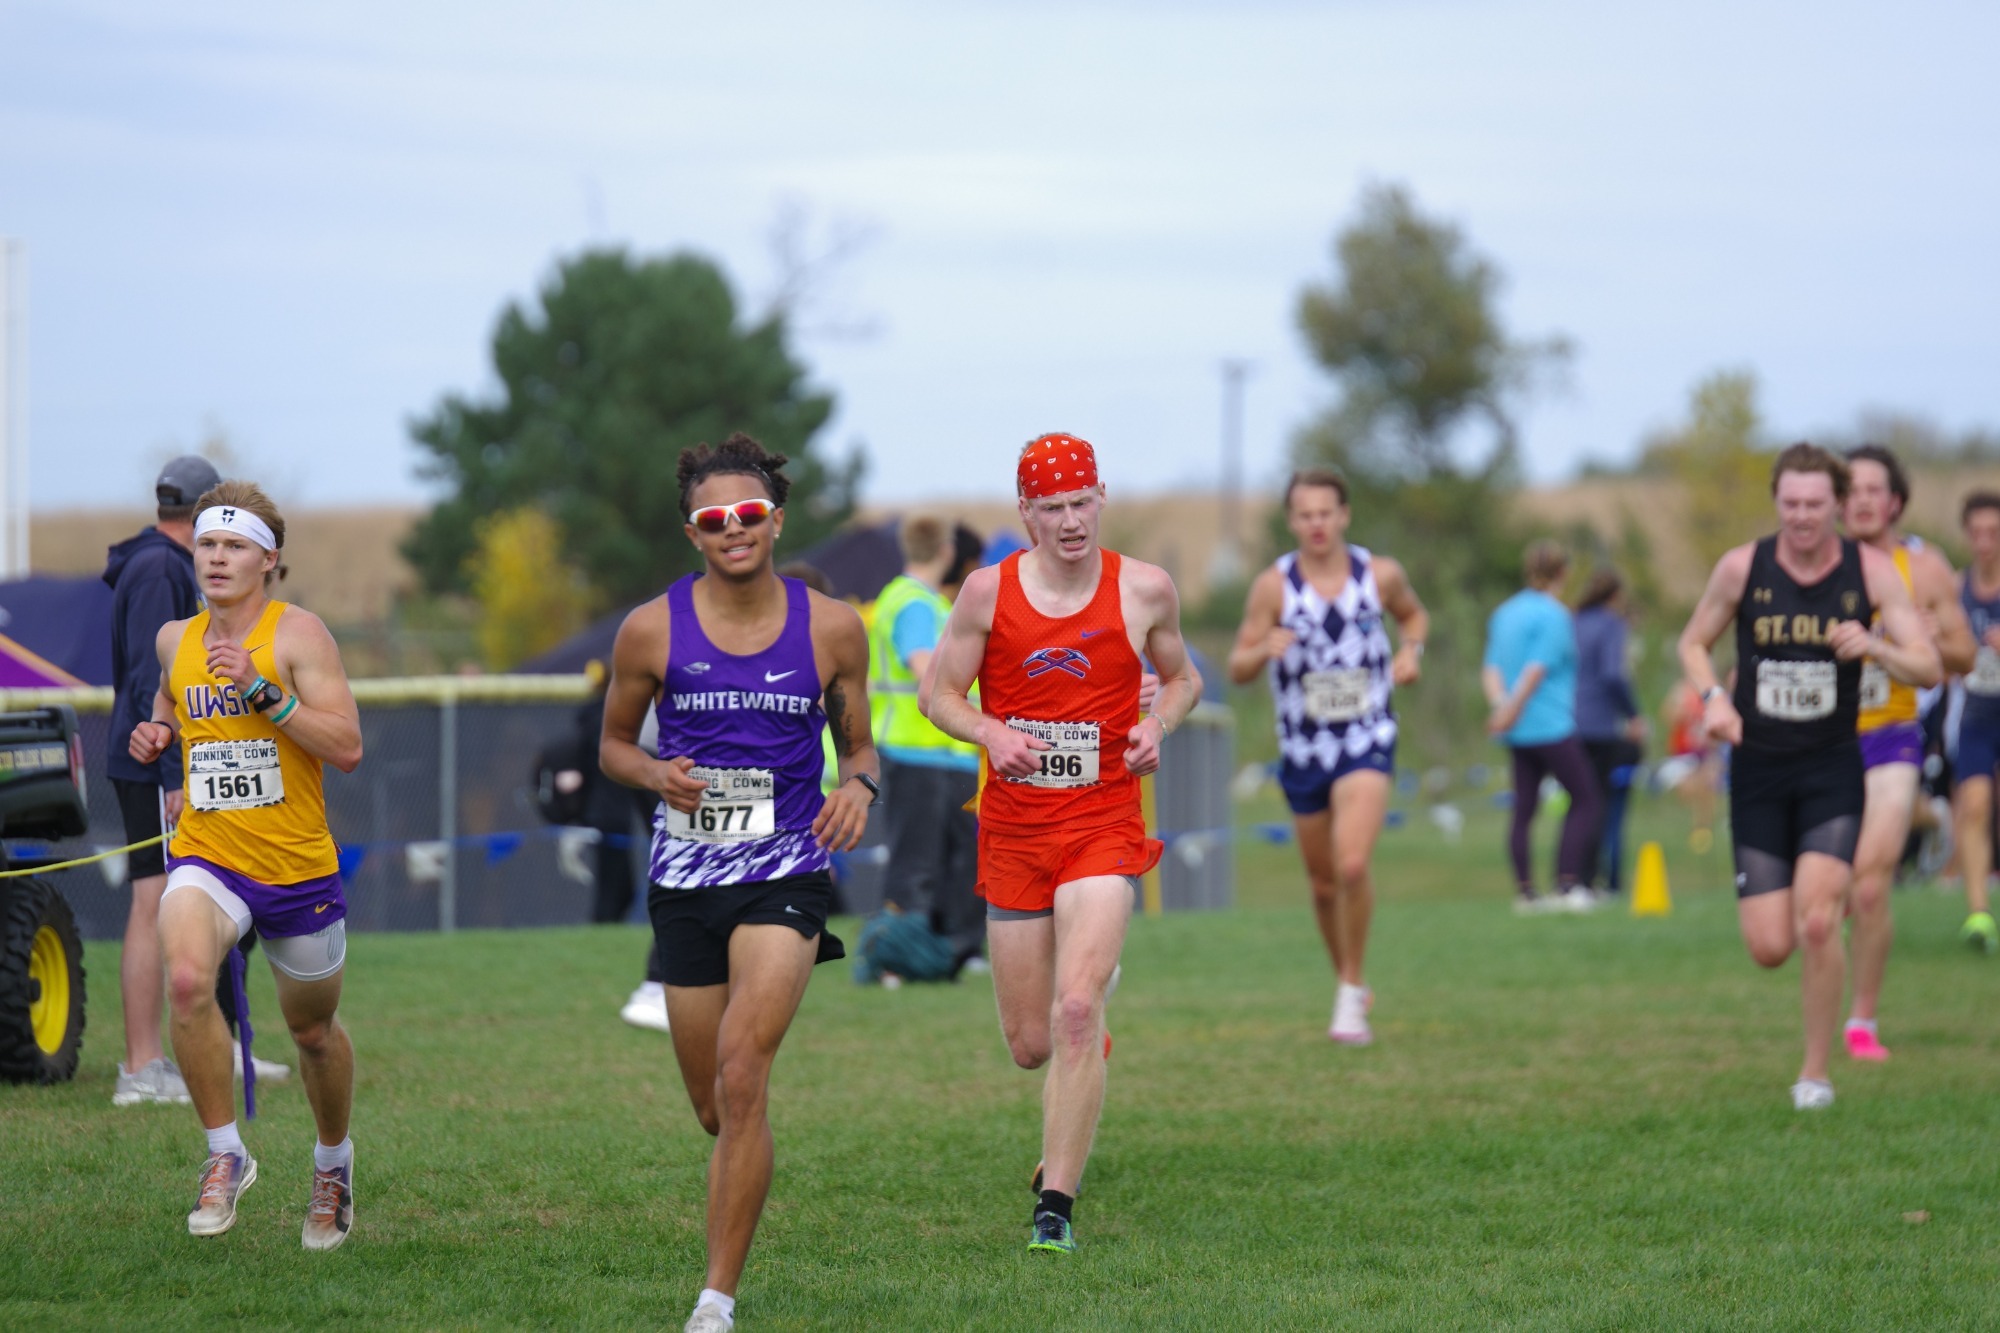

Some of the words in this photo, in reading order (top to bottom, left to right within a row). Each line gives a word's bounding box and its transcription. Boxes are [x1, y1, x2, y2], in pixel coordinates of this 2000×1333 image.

[1753, 614, 1790, 646] ST.
[1791, 613, 1840, 646] OLA
[185, 684, 250, 720] UWS
[672, 690, 812, 714] WHITEWATER
[1023, 722, 1052, 730] CARLETON
[1064, 730, 1098, 740] COWS
[191, 750, 233, 762] RUNNING
[244, 747, 277, 759] COWS
[204, 773, 263, 799] 1561
[733, 777, 771, 788] COWS
[688, 804, 753, 832] 1677
